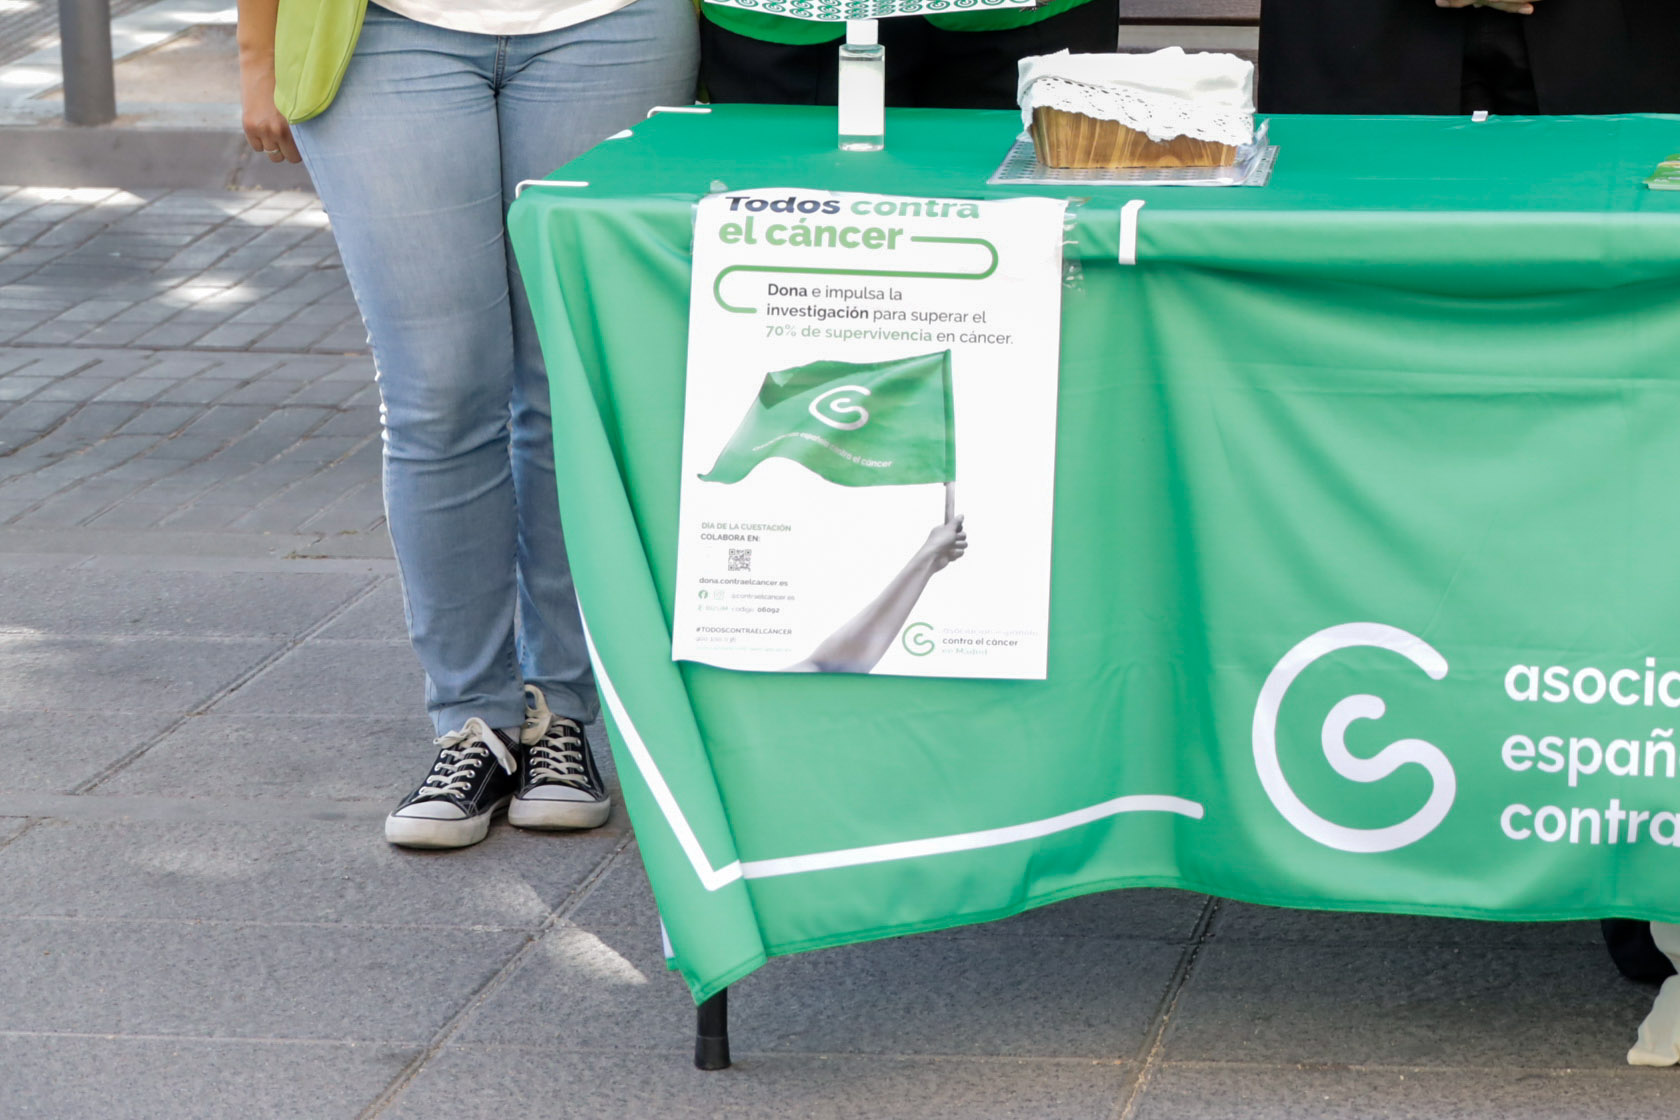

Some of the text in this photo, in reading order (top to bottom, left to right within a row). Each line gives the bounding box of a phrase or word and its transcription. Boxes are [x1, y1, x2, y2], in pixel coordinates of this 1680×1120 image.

[725, 196, 980, 218] Todos contra
[719, 215, 904, 250] el cáncer
[768, 283, 903, 302] Dona e impulsa la
[767, 304, 986, 325] investigación para superar el
[766, 325, 1014, 345] 70% de supervivencia en cáncer.
[852, 455, 860, 463] el
[741, 524, 792, 532] CUESTACIÓN
